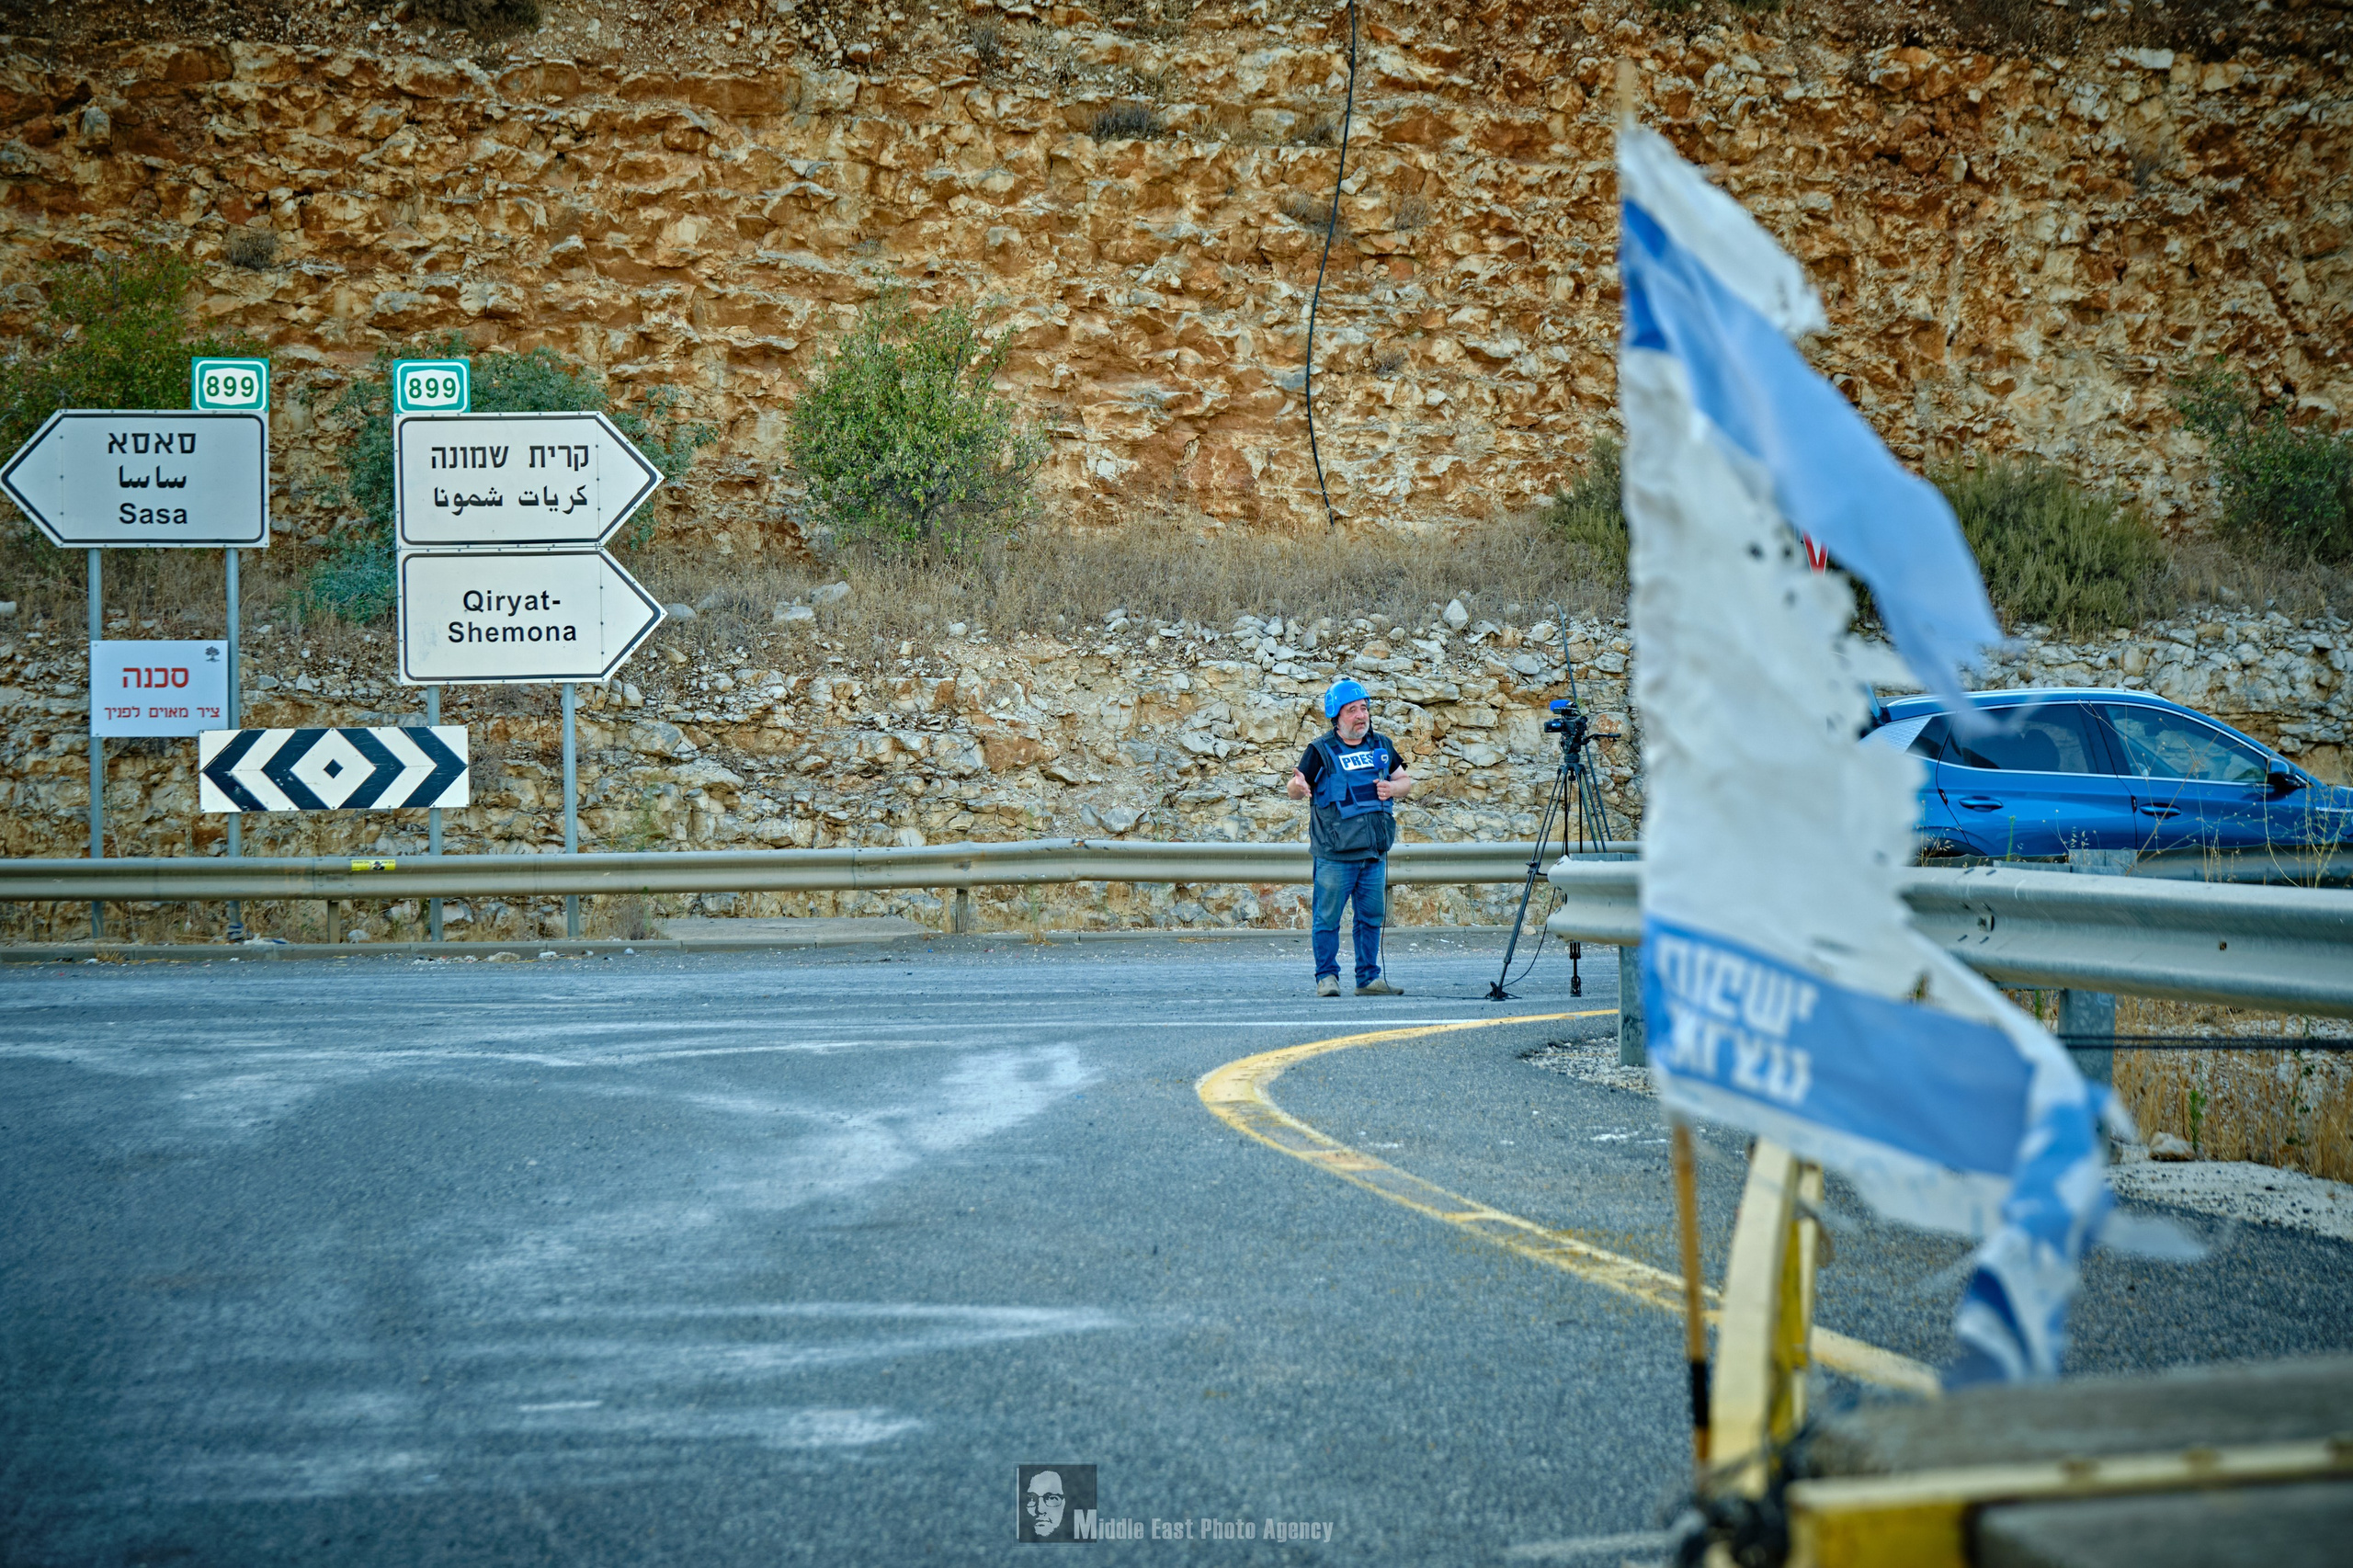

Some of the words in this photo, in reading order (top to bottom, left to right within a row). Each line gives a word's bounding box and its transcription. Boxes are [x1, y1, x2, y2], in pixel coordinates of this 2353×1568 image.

[206, 375, 255, 398] 899
[408, 377, 457, 399] 899
[108, 432, 197, 455] סאסא
[431, 445, 510, 469] שמונה
[529, 445, 589, 472] קרית
[119, 464, 188, 489] ساسا
[433, 485, 504, 517] شمونا
[517, 483, 588, 515] كريات
[119, 502, 188, 525] Sasa
[462, 589, 562, 618] Qiryat-
[448, 620, 577, 643] Shemona
[122, 666, 189, 689] סכנה
[104, 705, 141, 721] לפניך
[148, 707, 189, 719] מאוים
[196, 707, 221, 719] ציר
[1342, 753, 1374, 768] PRES
